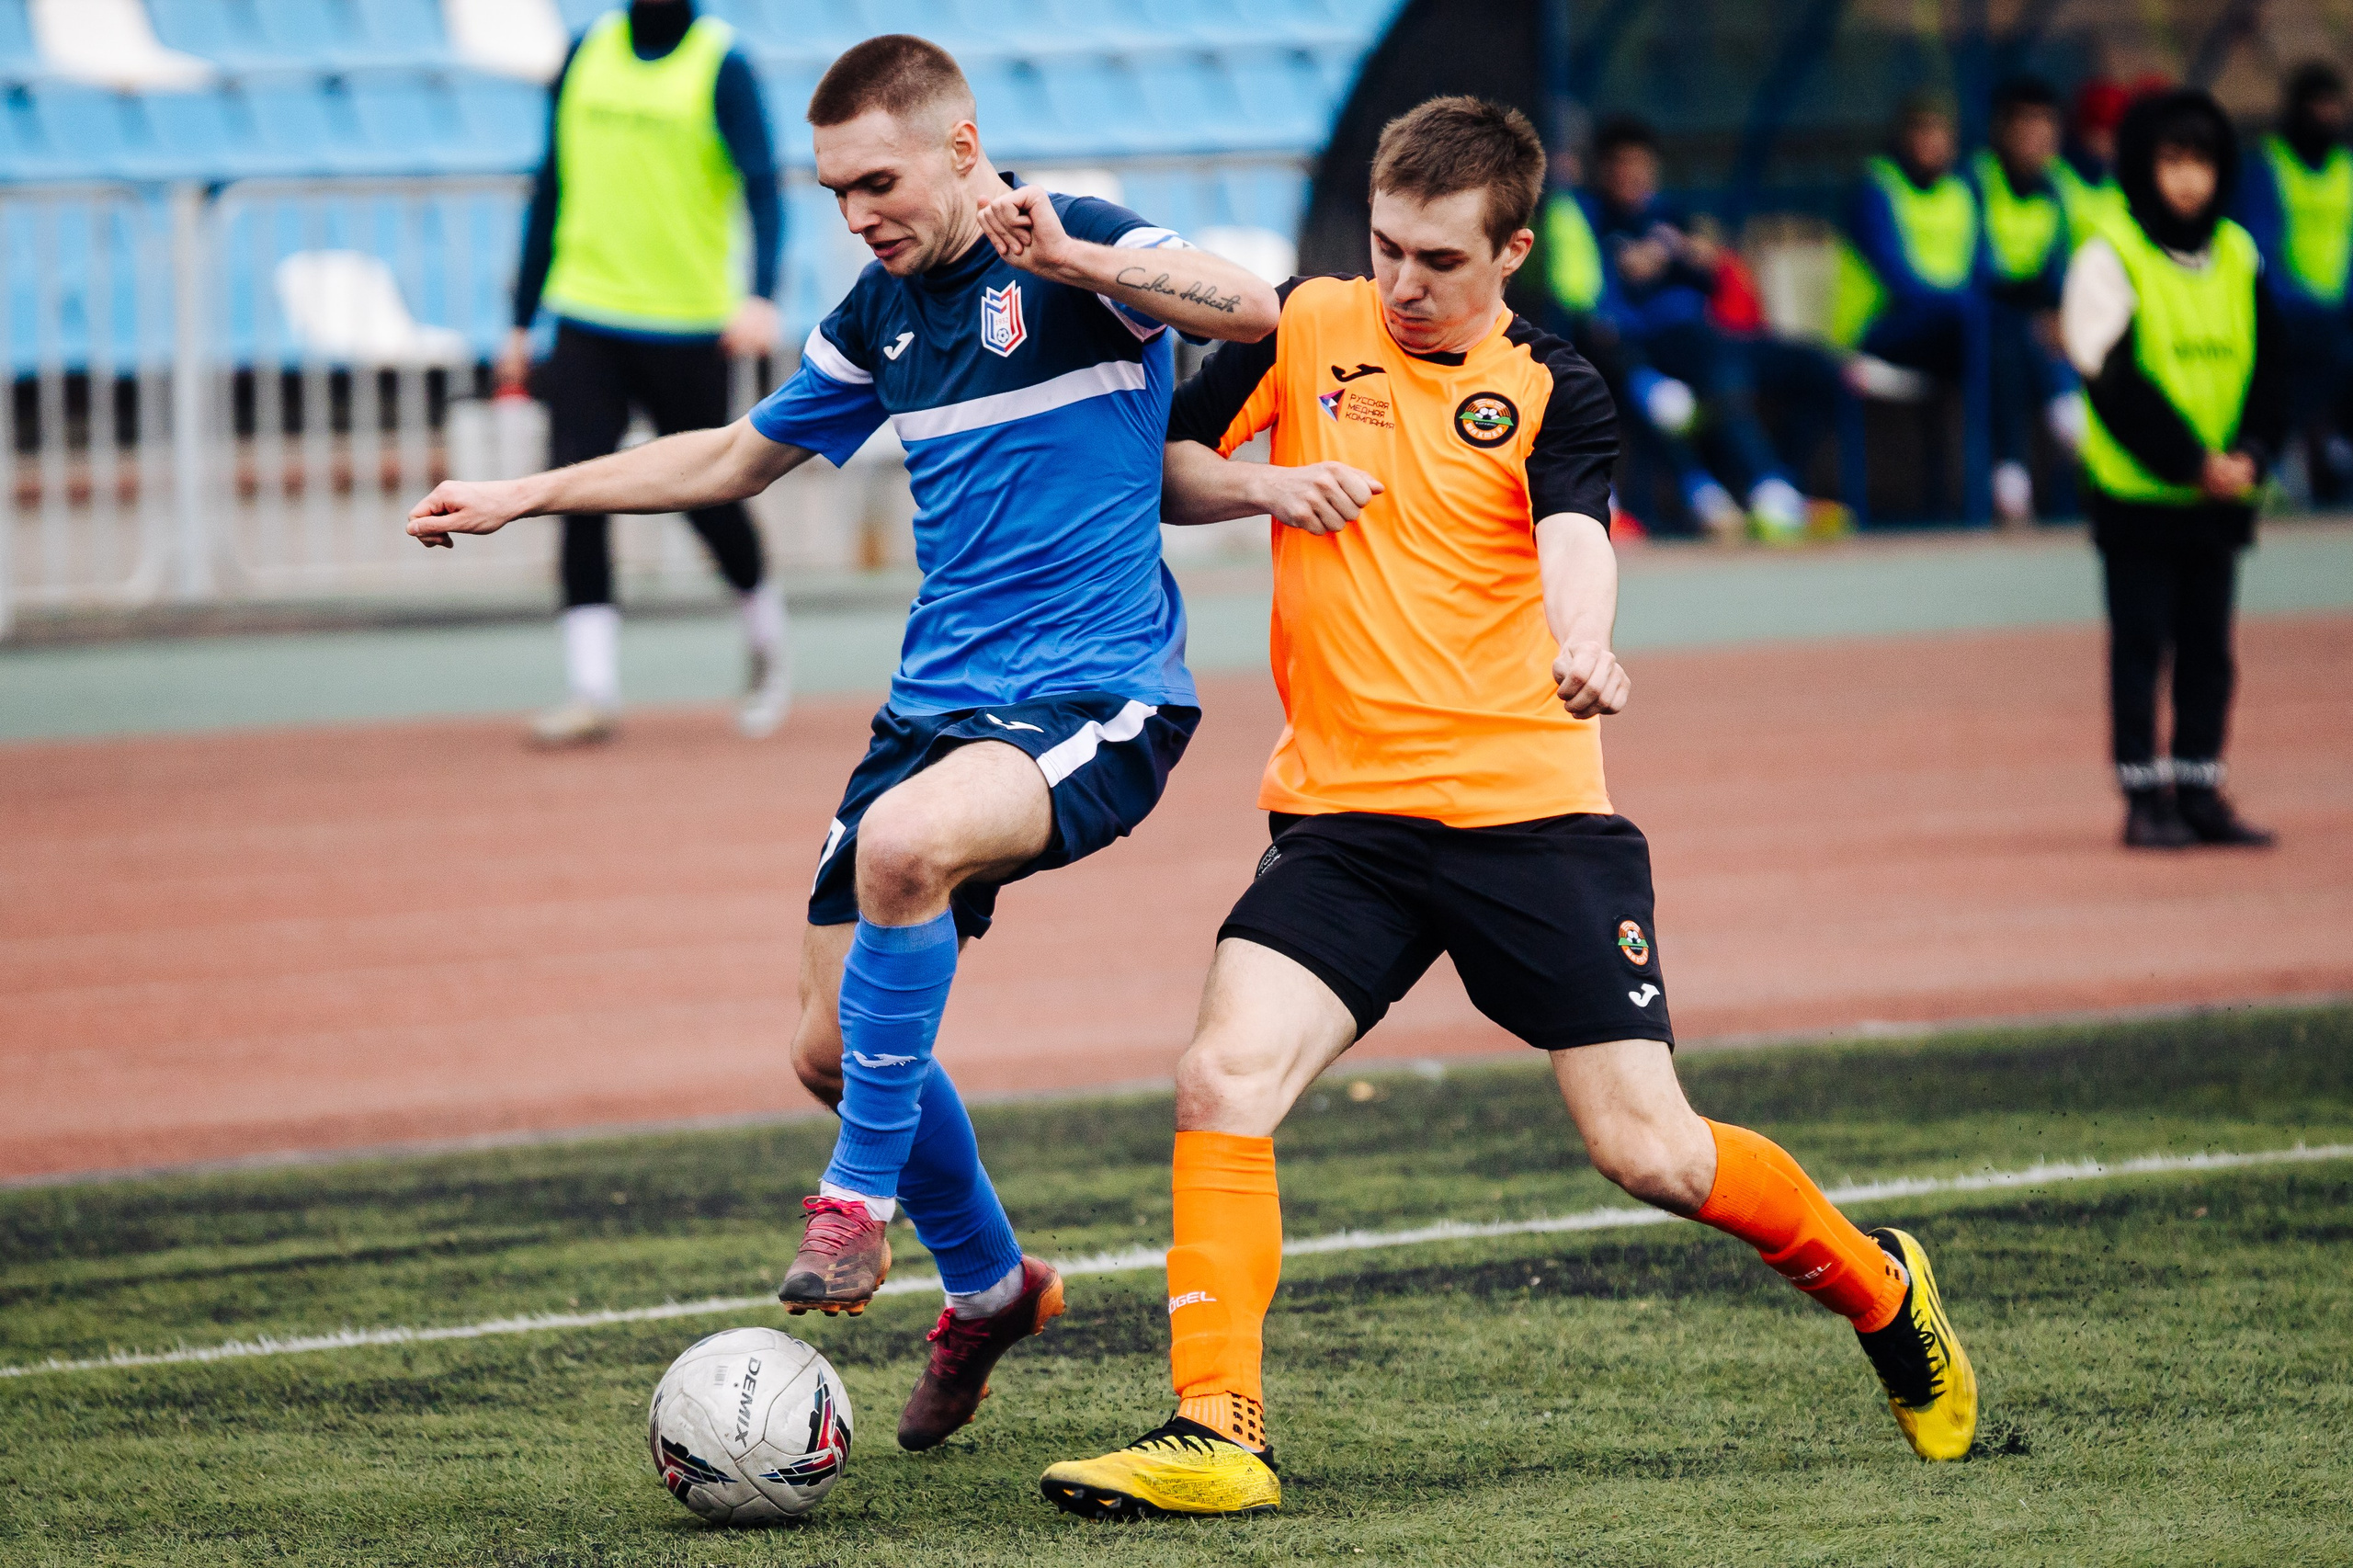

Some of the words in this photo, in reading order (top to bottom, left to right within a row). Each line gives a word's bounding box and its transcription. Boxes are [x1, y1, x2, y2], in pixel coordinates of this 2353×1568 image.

[1350, 393, 1390, 409] РУССКАЯ
[1347, 403, 1385, 418] МЕДНАЯ
[1345, 411, 1395, 430] КОМПАНИЯ
[734, 1357, 762, 1449] DEMIX
